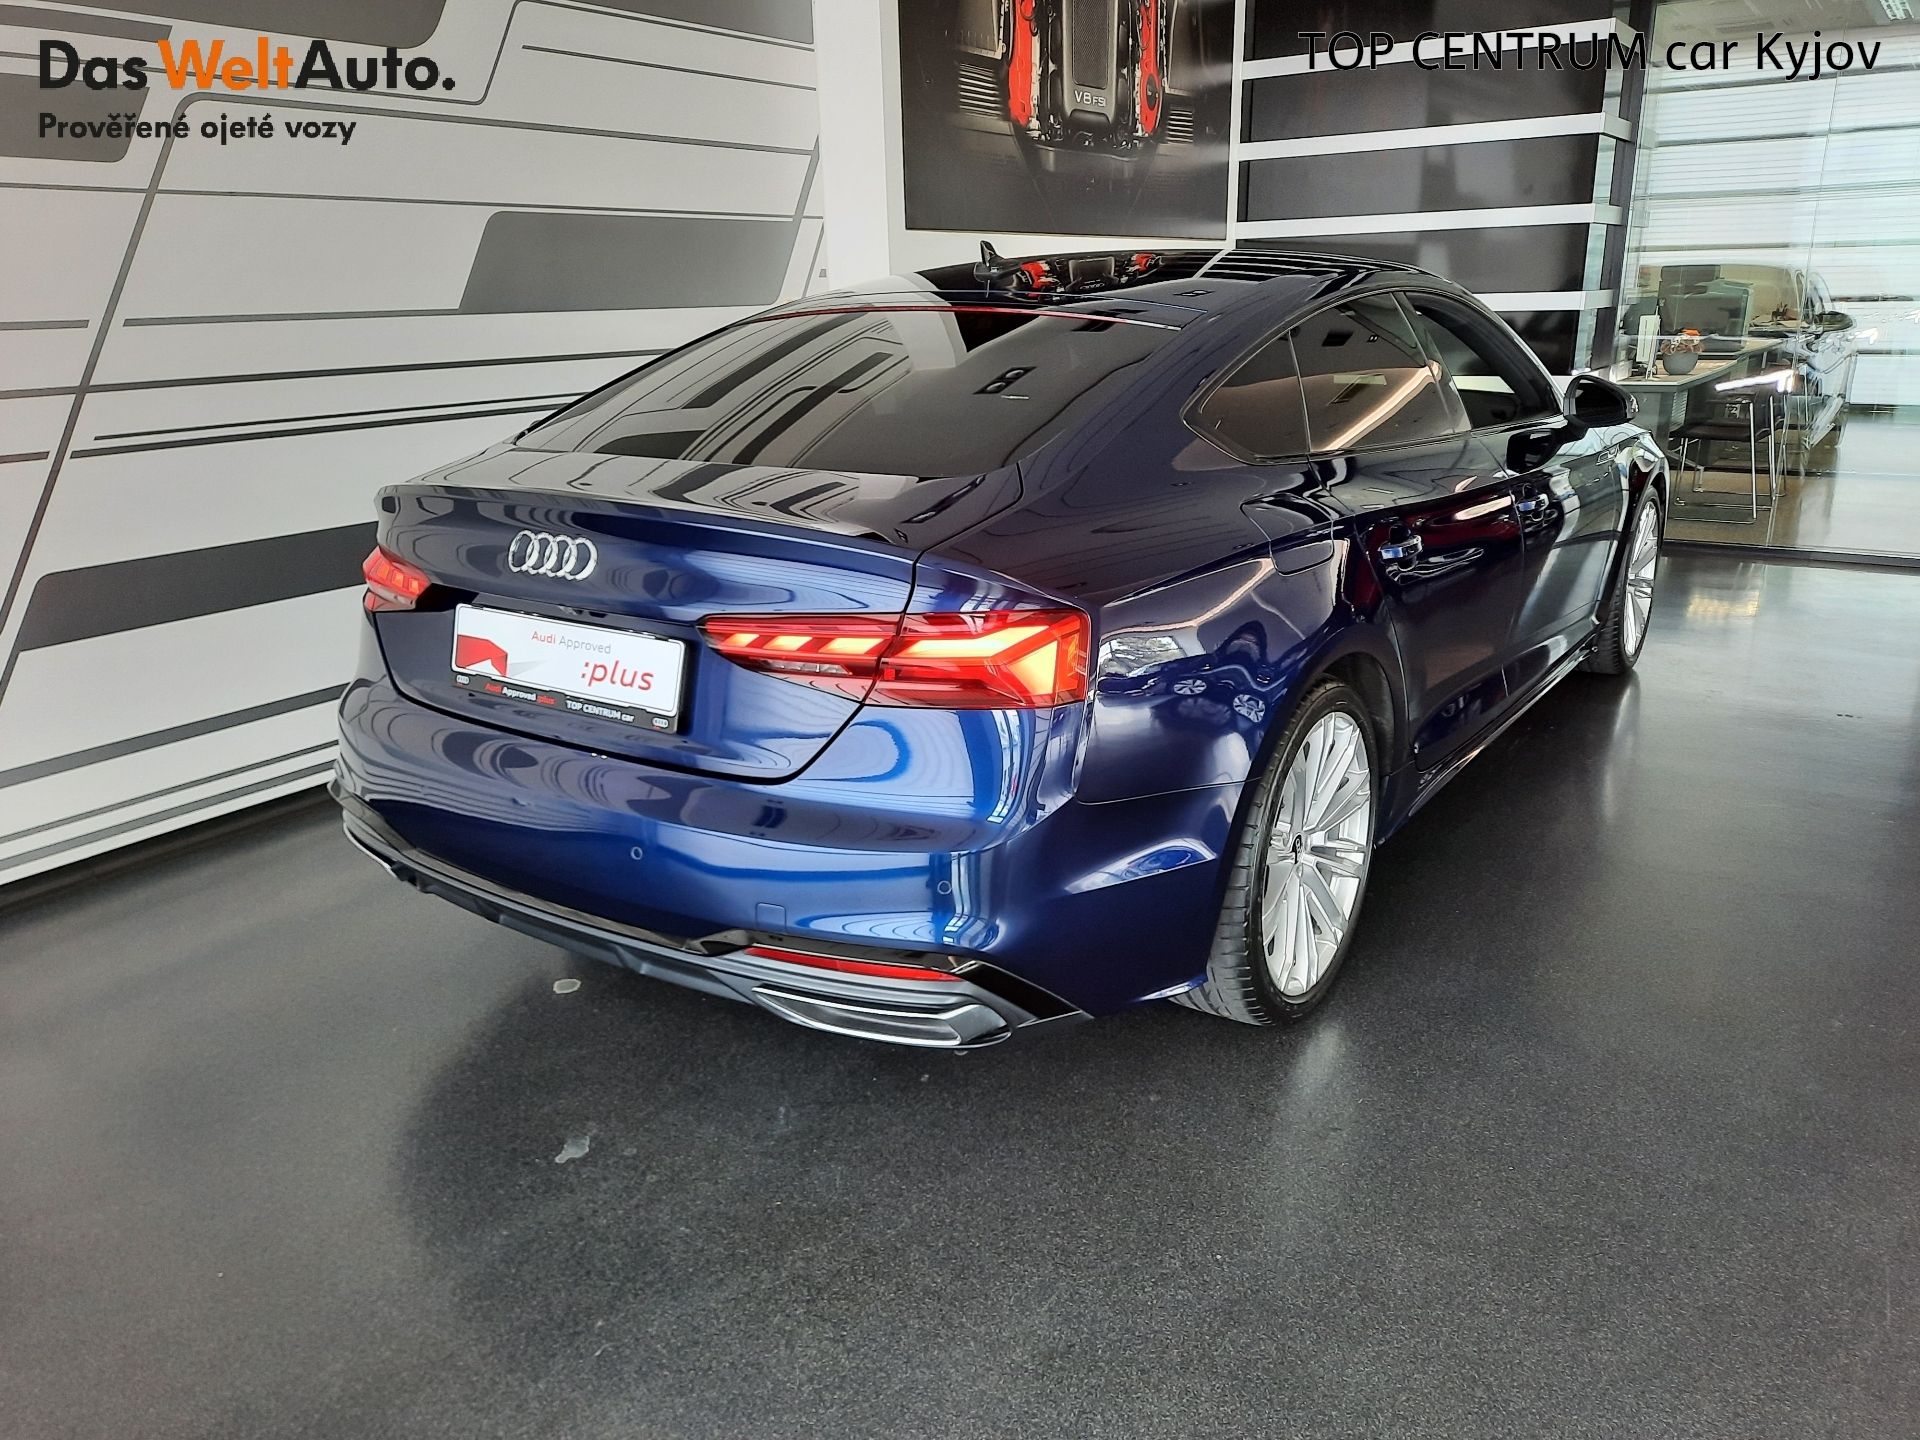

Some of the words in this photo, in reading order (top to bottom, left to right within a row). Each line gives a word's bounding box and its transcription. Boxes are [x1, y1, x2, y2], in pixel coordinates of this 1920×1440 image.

[531, 630, 556, 644] Audi
[558, 635, 612, 655] Approved
[502, 686, 537, 701] Approved
[565, 700, 583, 711] TOP
[583, 703, 621, 720] CENTRUM
[621, 712, 635, 723] car
